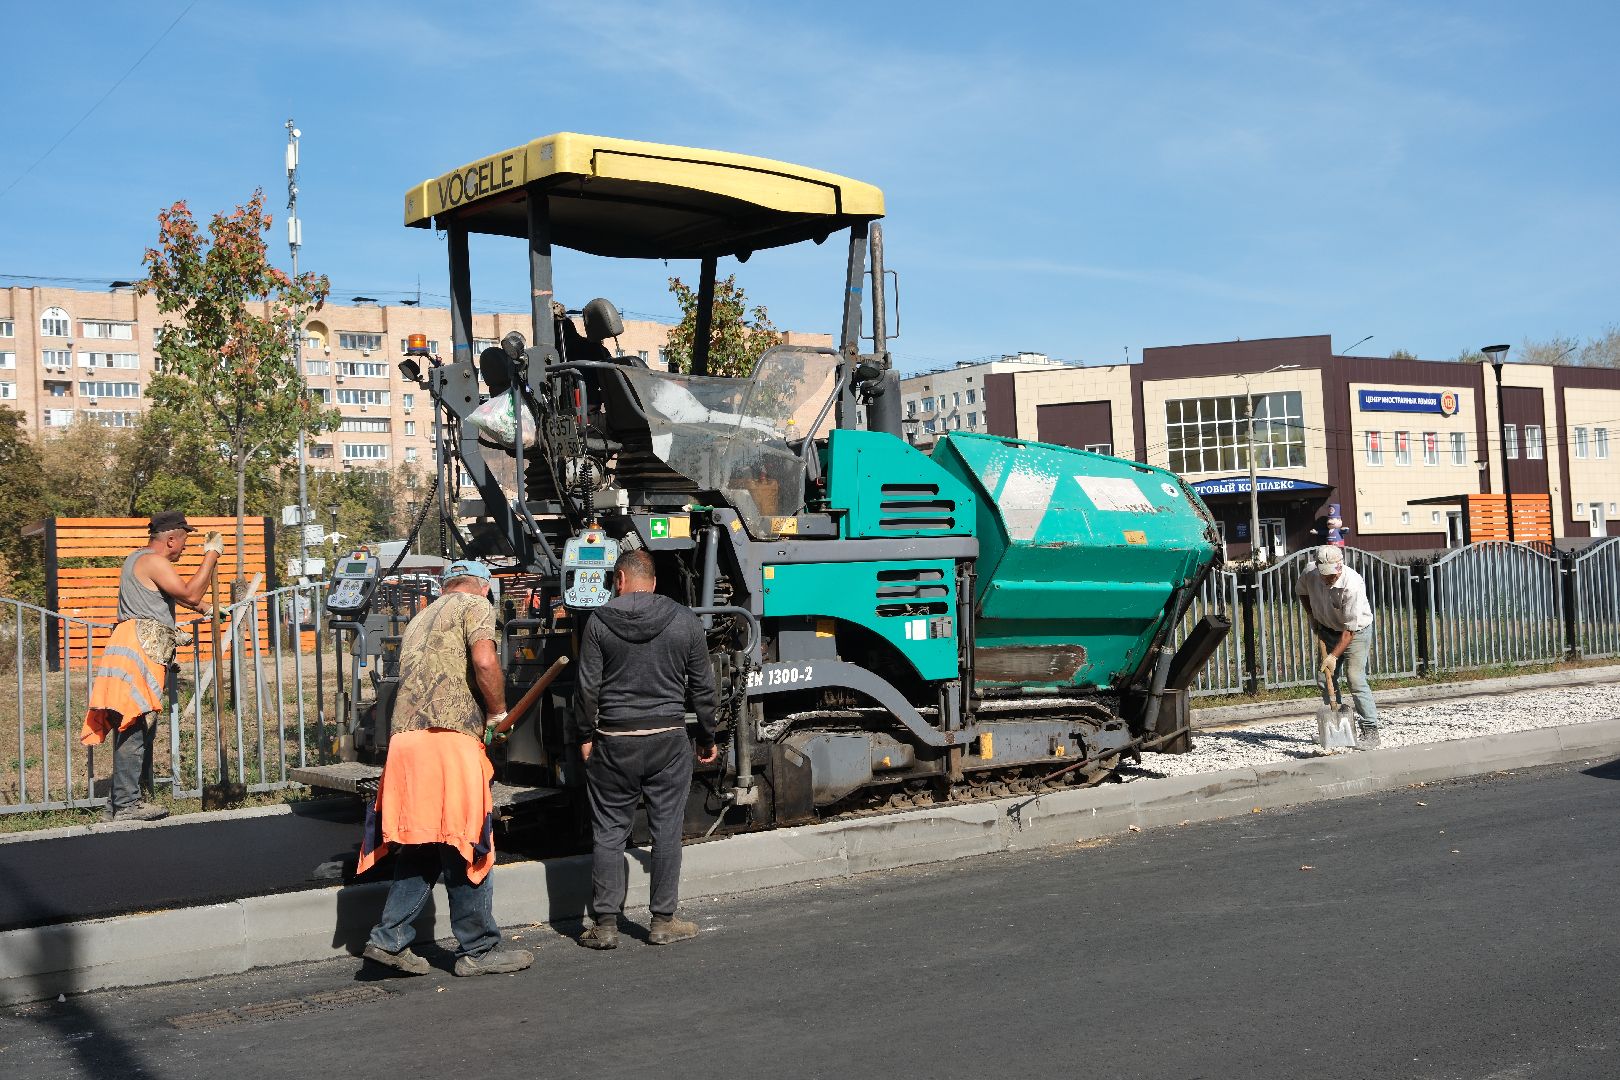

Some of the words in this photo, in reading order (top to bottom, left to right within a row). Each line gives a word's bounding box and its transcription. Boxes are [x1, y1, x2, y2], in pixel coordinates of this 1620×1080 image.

[438, 154, 514, 209] VÖGELE
[1365, 395, 1381, 404] ЦЕНТР
[1381, 396, 1418, 405] ИНОСТРАННЫХ
[1417, 397, 1437, 406] ЯЗЫКОВ
[1193, 482, 1236, 494] РГОВЫЙ
[768, 665, 813, 686] 1300-2
